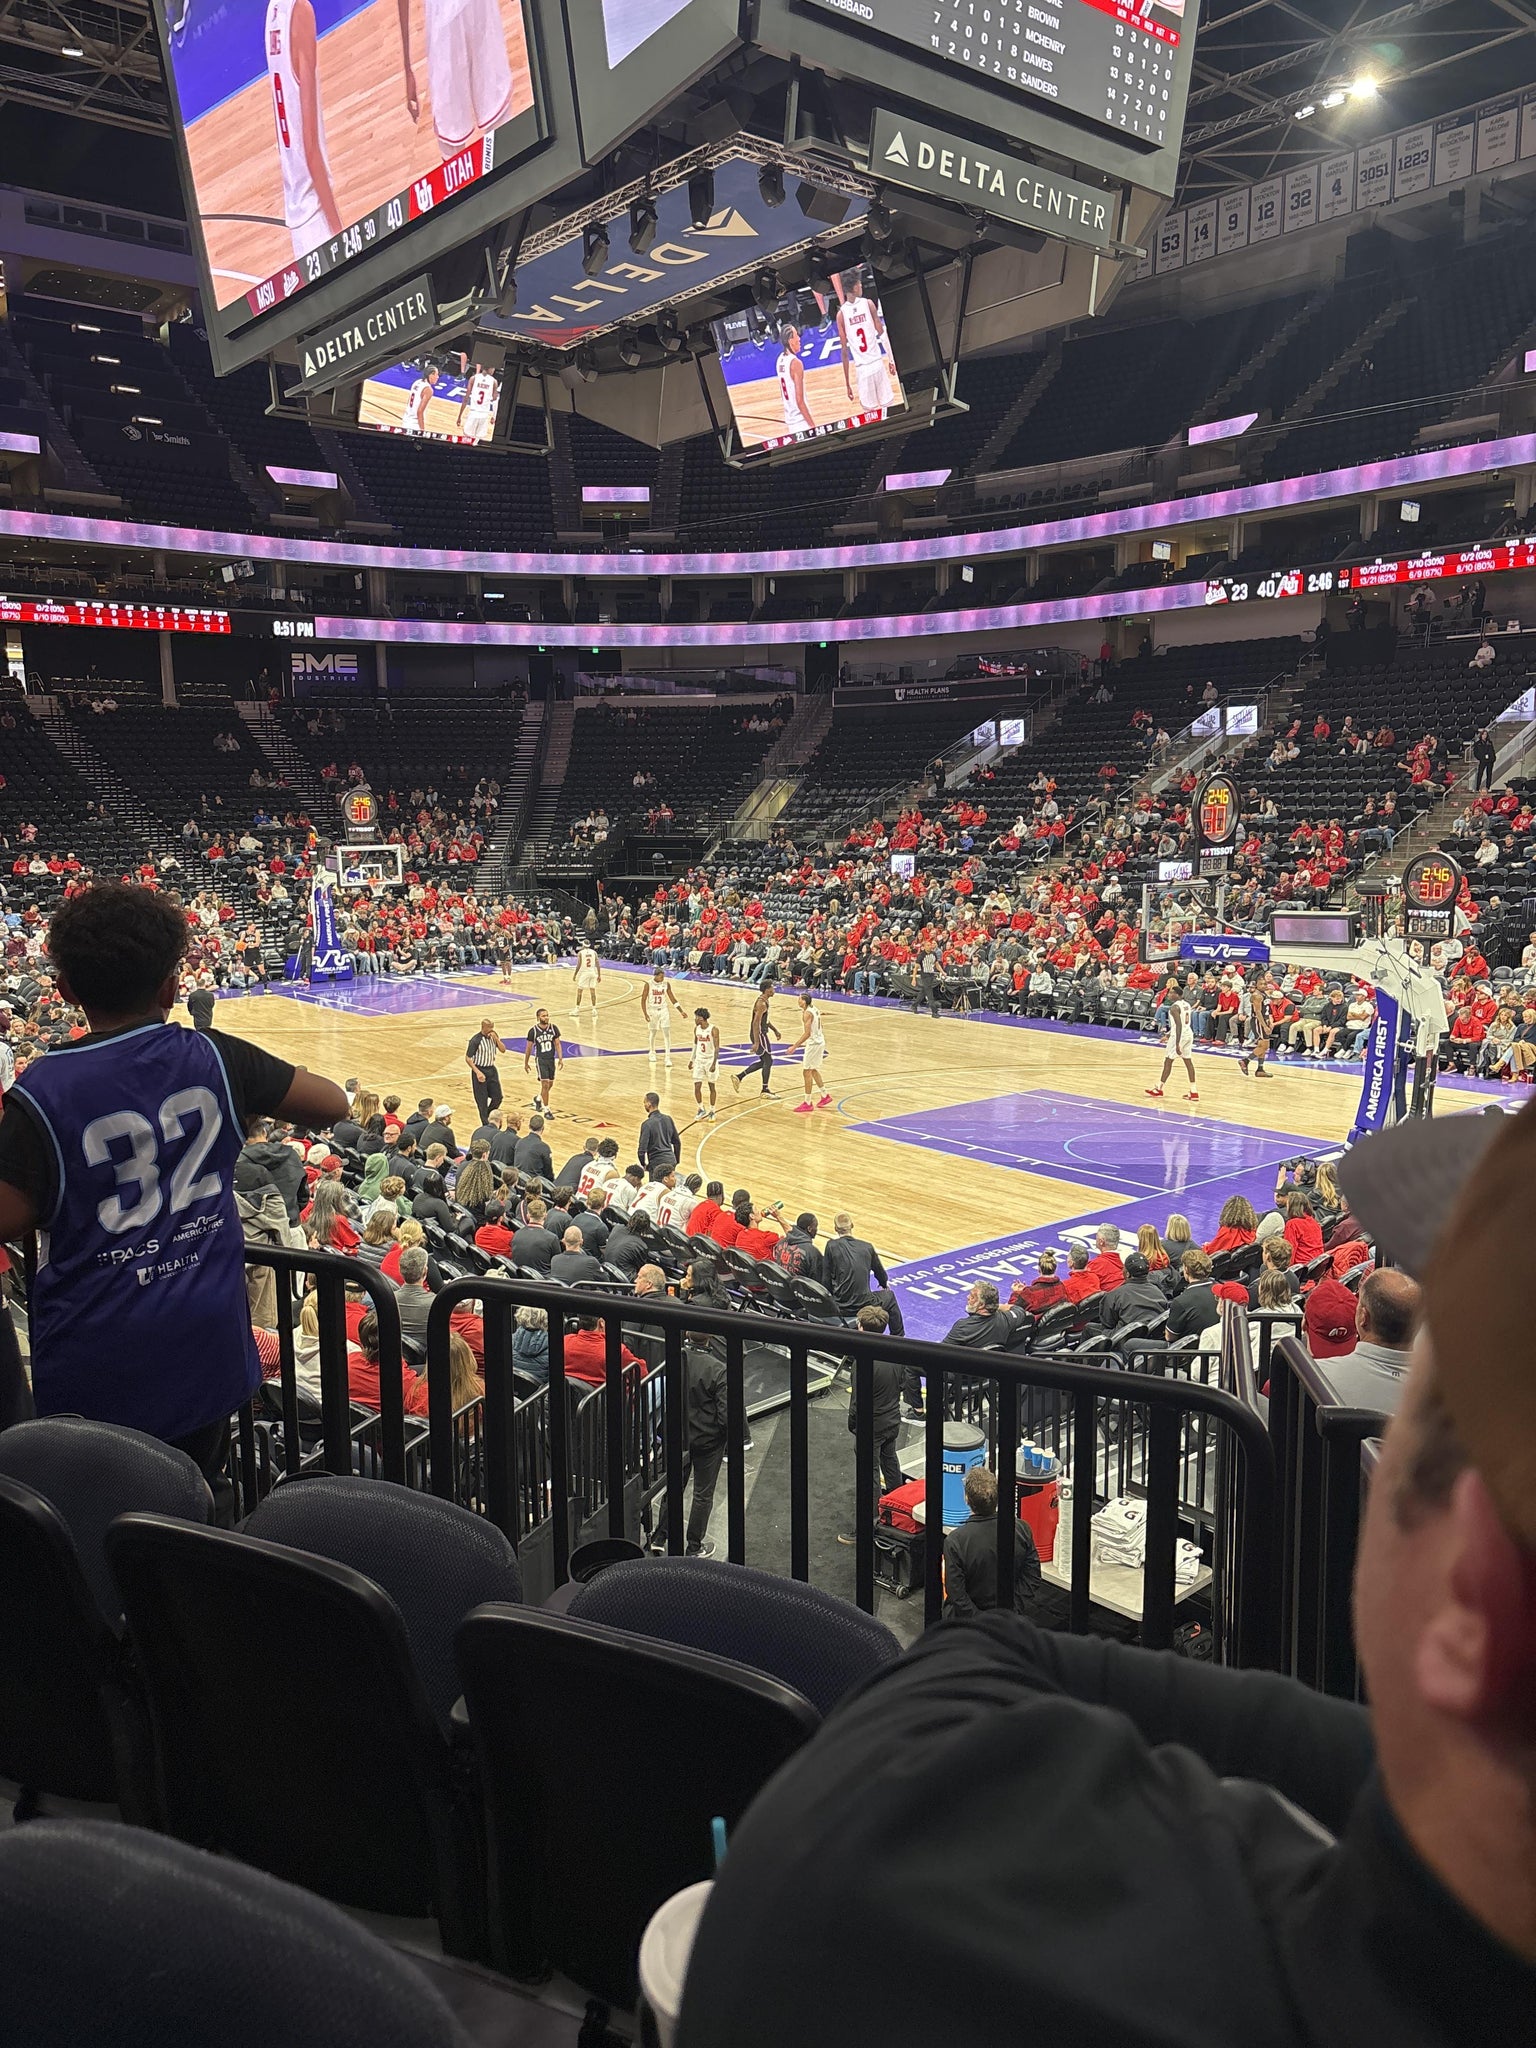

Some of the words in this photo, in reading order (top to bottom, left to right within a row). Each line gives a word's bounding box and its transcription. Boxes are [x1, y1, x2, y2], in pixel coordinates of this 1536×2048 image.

[969, 3, 974, 15] 1
[983, 10, 991, 22] 0
[1000, 17, 1005, 28] 1
[934, 11, 941, 24] 7
[950, 20, 958, 32] 4
[965, 26, 973, 38] 0
[981, 32, 988, 45] 0
[997, 39, 1003, 51] 1
[1015, 0, 1022, 13] 2
[1028, 5, 1060, 30] BROWN
[1112, 45, 1122, 58] 13
[1127, 52, 1134, 64] 8
[1141, 58, 1146, 69] 1
[1152, 63, 1159, 75] 2
[1165, 69, 1171, 81] 0
[1115, 24, 1124, 37] 13
[1130, 31, 1137, 43] 3
[1143, 37, 1149, 49] 4
[1154, 43, 1161, 55] 0
[1168, 49, 1173, 61] 1
[931, 35, 940, 48] 11
[948, 42, 956, 55] 2
[963, 48, 970, 61] 0
[979, 54, 986, 68] 2
[993, 61, 1001, 74] 2
[1013, 22, 1020, 35] 3
[1025, 28, 1066, 56] MCHENRY
[1109, 66, 1119, 79] 13
[1124, 72, 1133, 86] 15
[1137, 78, 1144, 91] 2
[1150, 84, 1156, 96] 0
[1162, 89, 1169, 101] 0
[1010, 44, 1018, 57] 8
[1023, 50, 1054, 73] DAWES
[1107, 87, 1116, 100] 14
[1122, 93, 1129, 105] 7
[1135, 99, 1142, 111] 2
[1147, 104, 1153, 116] 0
[1159, 109, 1166, 121] 0
[1007, 66, 1017, 80] 13
[1020, 72, 1059, 98] SANDERS
[1106, 108, 1113, 120] 8
[1120, 114, 1126, 126] 2
[1133, 120, 1138, 132] 1
[1145, 125, 1150, 136] 1
[1158, 130, 1163, 141] 1
[1398, 149, 1430, 171] 1223
[1360, 162, 1389, 183] 3051
[918, 141, 1005, 197] DELTA
[1016, 177, 1105, 230] CENTER
[1332, 178, 1342, 196] 4
[1290, 189, 1312, 211] 32
[1228, 213, 1238, 231] 9
[1257, 201, 1275, 222] 12
[256, 282, 275, 309] MSU
[307, 254, 321, 281] 23
[330, 241, 339, 262] 1ST
[342, 224, 363, 259] 2:46
[364, 219, 376, 240] 30
[387, 198, 403, 229] 40
[443, 151, 474, 191] UTAH
[485, 137, 493, 171] BONUS
[1194, 223, 1209, 243] 14
[1161, 233, 1180, 253] 53
[512, 242, 710, 322] DELTA
[315, 327, 364, 368] DELTA
[366, 292, 427, 341] CENTER
[856, 328, 867, 353] 3
[477, 390, 485, 405] 3
[1460, 552, 1475, 562] 0/2
[1509, 547, 1515, 556] 2
[1508, 559, 1514, 567] 2
[1231, 583, 1248, 601] 23
[1257, 580, 1275, 598] 40
[1308, 572, 1333, 592] 2:46
[1339, 569, 1349, 578] 30
[273, 620, 295, 636] 8:51
[297, 622, 314, 637] PM
[907, 687, 929, 695] HEALTH
[930, 687, 950, 695] PLANS
[354, 797, 371, 806] 2:46
[1208, 789, 1229, 804] 2:46
[351, 806, 370, 821] 30
[1204, 806, 1226, 834] 30
[1211, 846, 1234, 856] TISSOT
[1422, 867, 1450, 882] 2:46
[1419, 882, 1443, 899] 30
[1420, 910, 1450, 918] TISSOT
[586, 958, 592, 967] 2
[653, 996, 662, 1005] 13
[536, 1033, 554, 1043] STATE
[540, 1042, 552, 1053] 10
[701, 1044, 706, 1053] 3
[1366, 1059, 1384, 1121] AMERICA
[1375, 1017, 1388, 1057] FIRST
[82, 1086, 223, 1235] 32
[578, 1174, 595, 1197] 32
[632, 1192, 647, 1208] 7
[657, 1206, 671, 1226] 10
[172, 1227, 207, 1243] AMERICA
[207, 1218, 225, 1231] FIRS
[110, 1239, 160, 1265] PACS
[956, 1240, 1040, 1268] UNIVERSITY
[157, 1252, 199, 1275] HEALTH
[932, 1263, 956, 1273] OF
[1124, 1510, 1139, 1520] G
